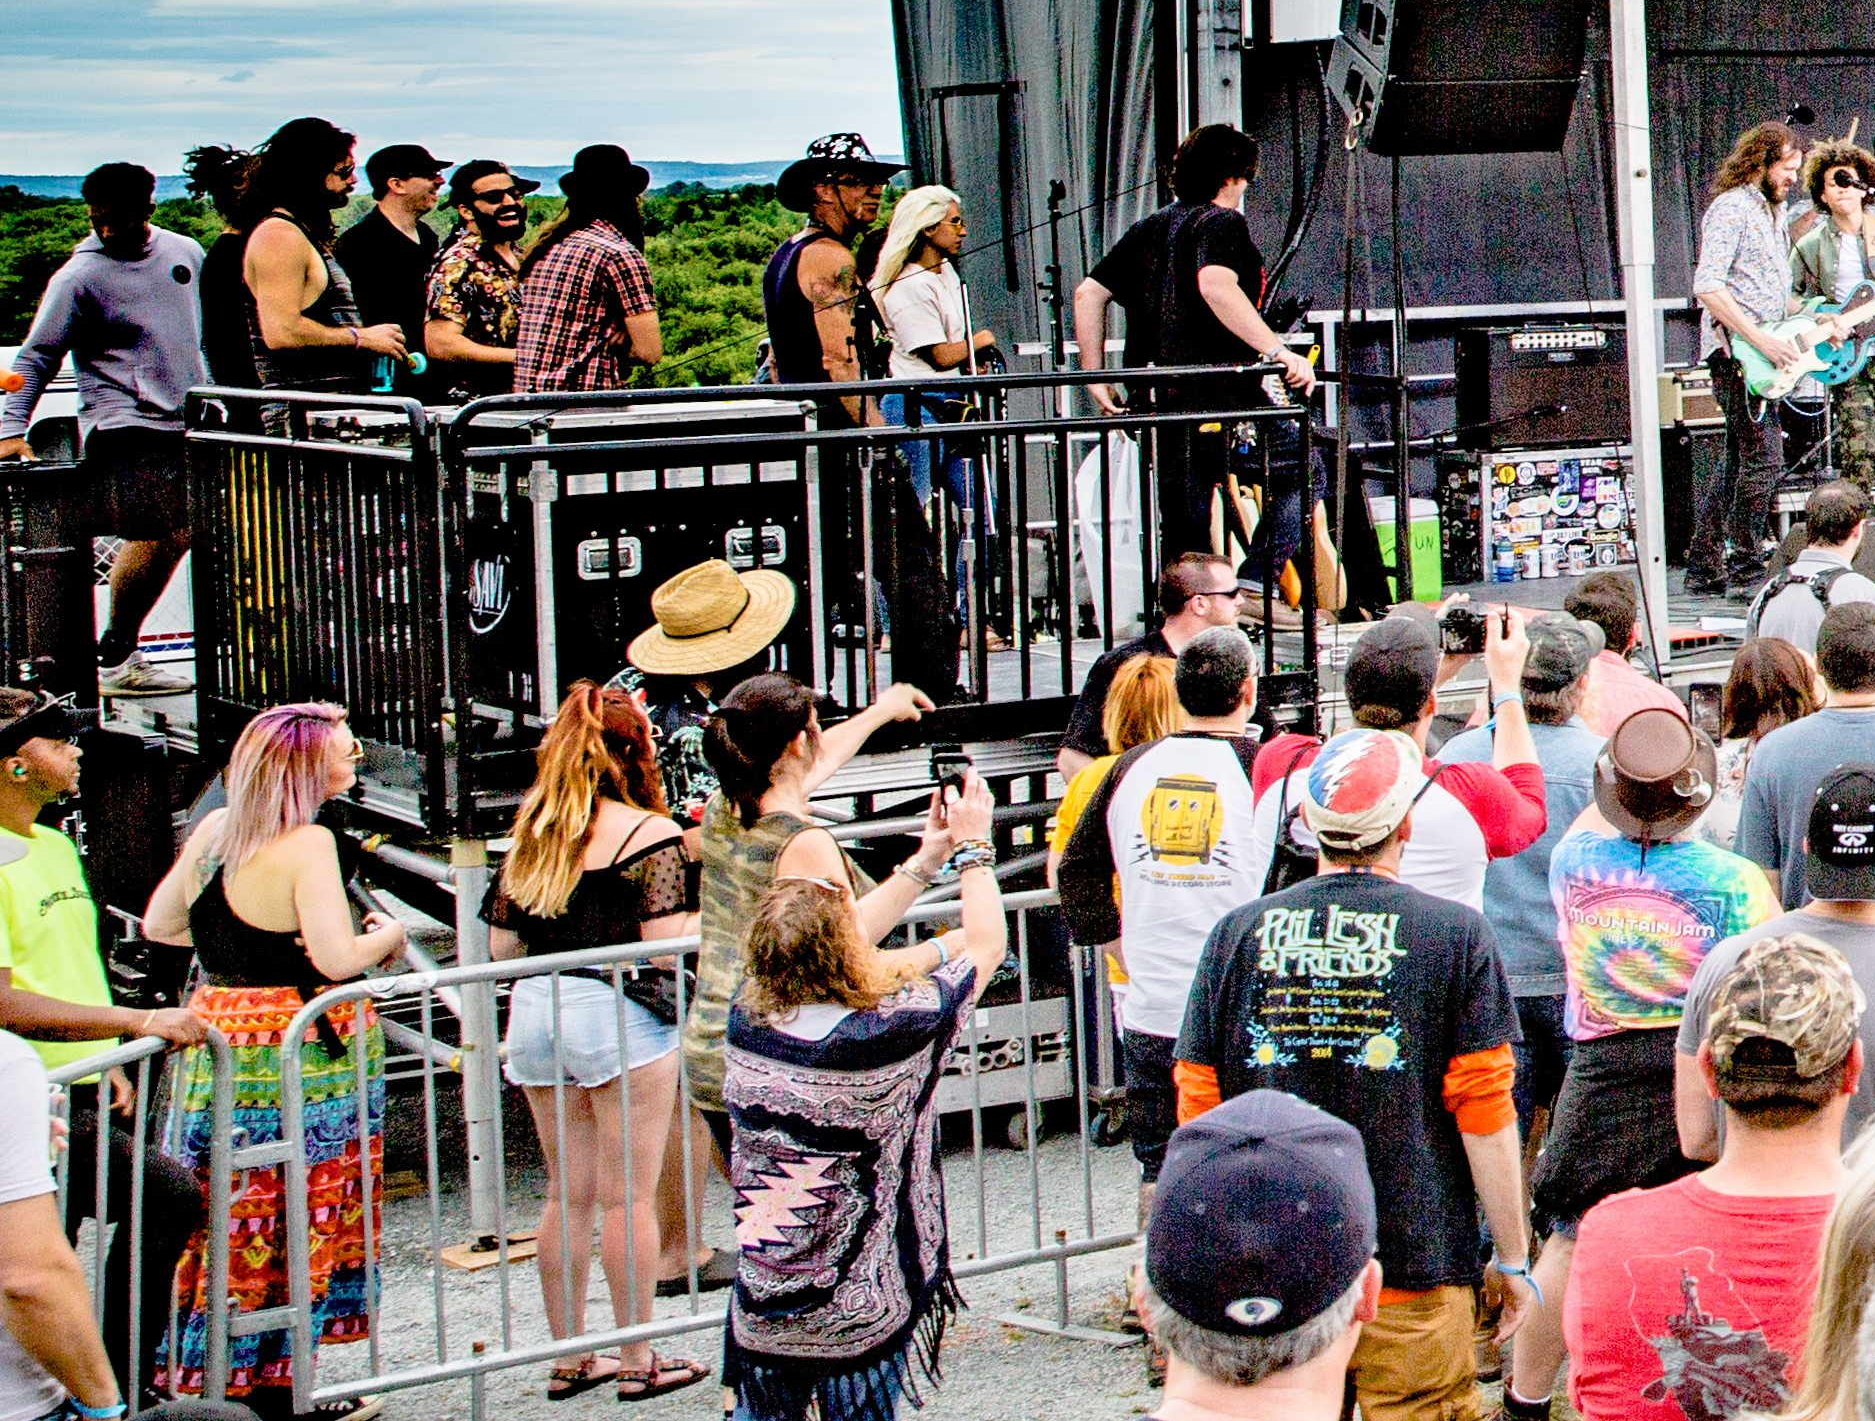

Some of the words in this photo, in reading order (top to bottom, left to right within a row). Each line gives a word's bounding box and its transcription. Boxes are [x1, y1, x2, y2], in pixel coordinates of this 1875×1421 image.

[1325, 903, 1408, 957] LESH
[1569, 906, 1671, 934] MOUNTAIN
[1673, 921, 1717, 939] JAM
[1258, 949, 1278, 971] &
